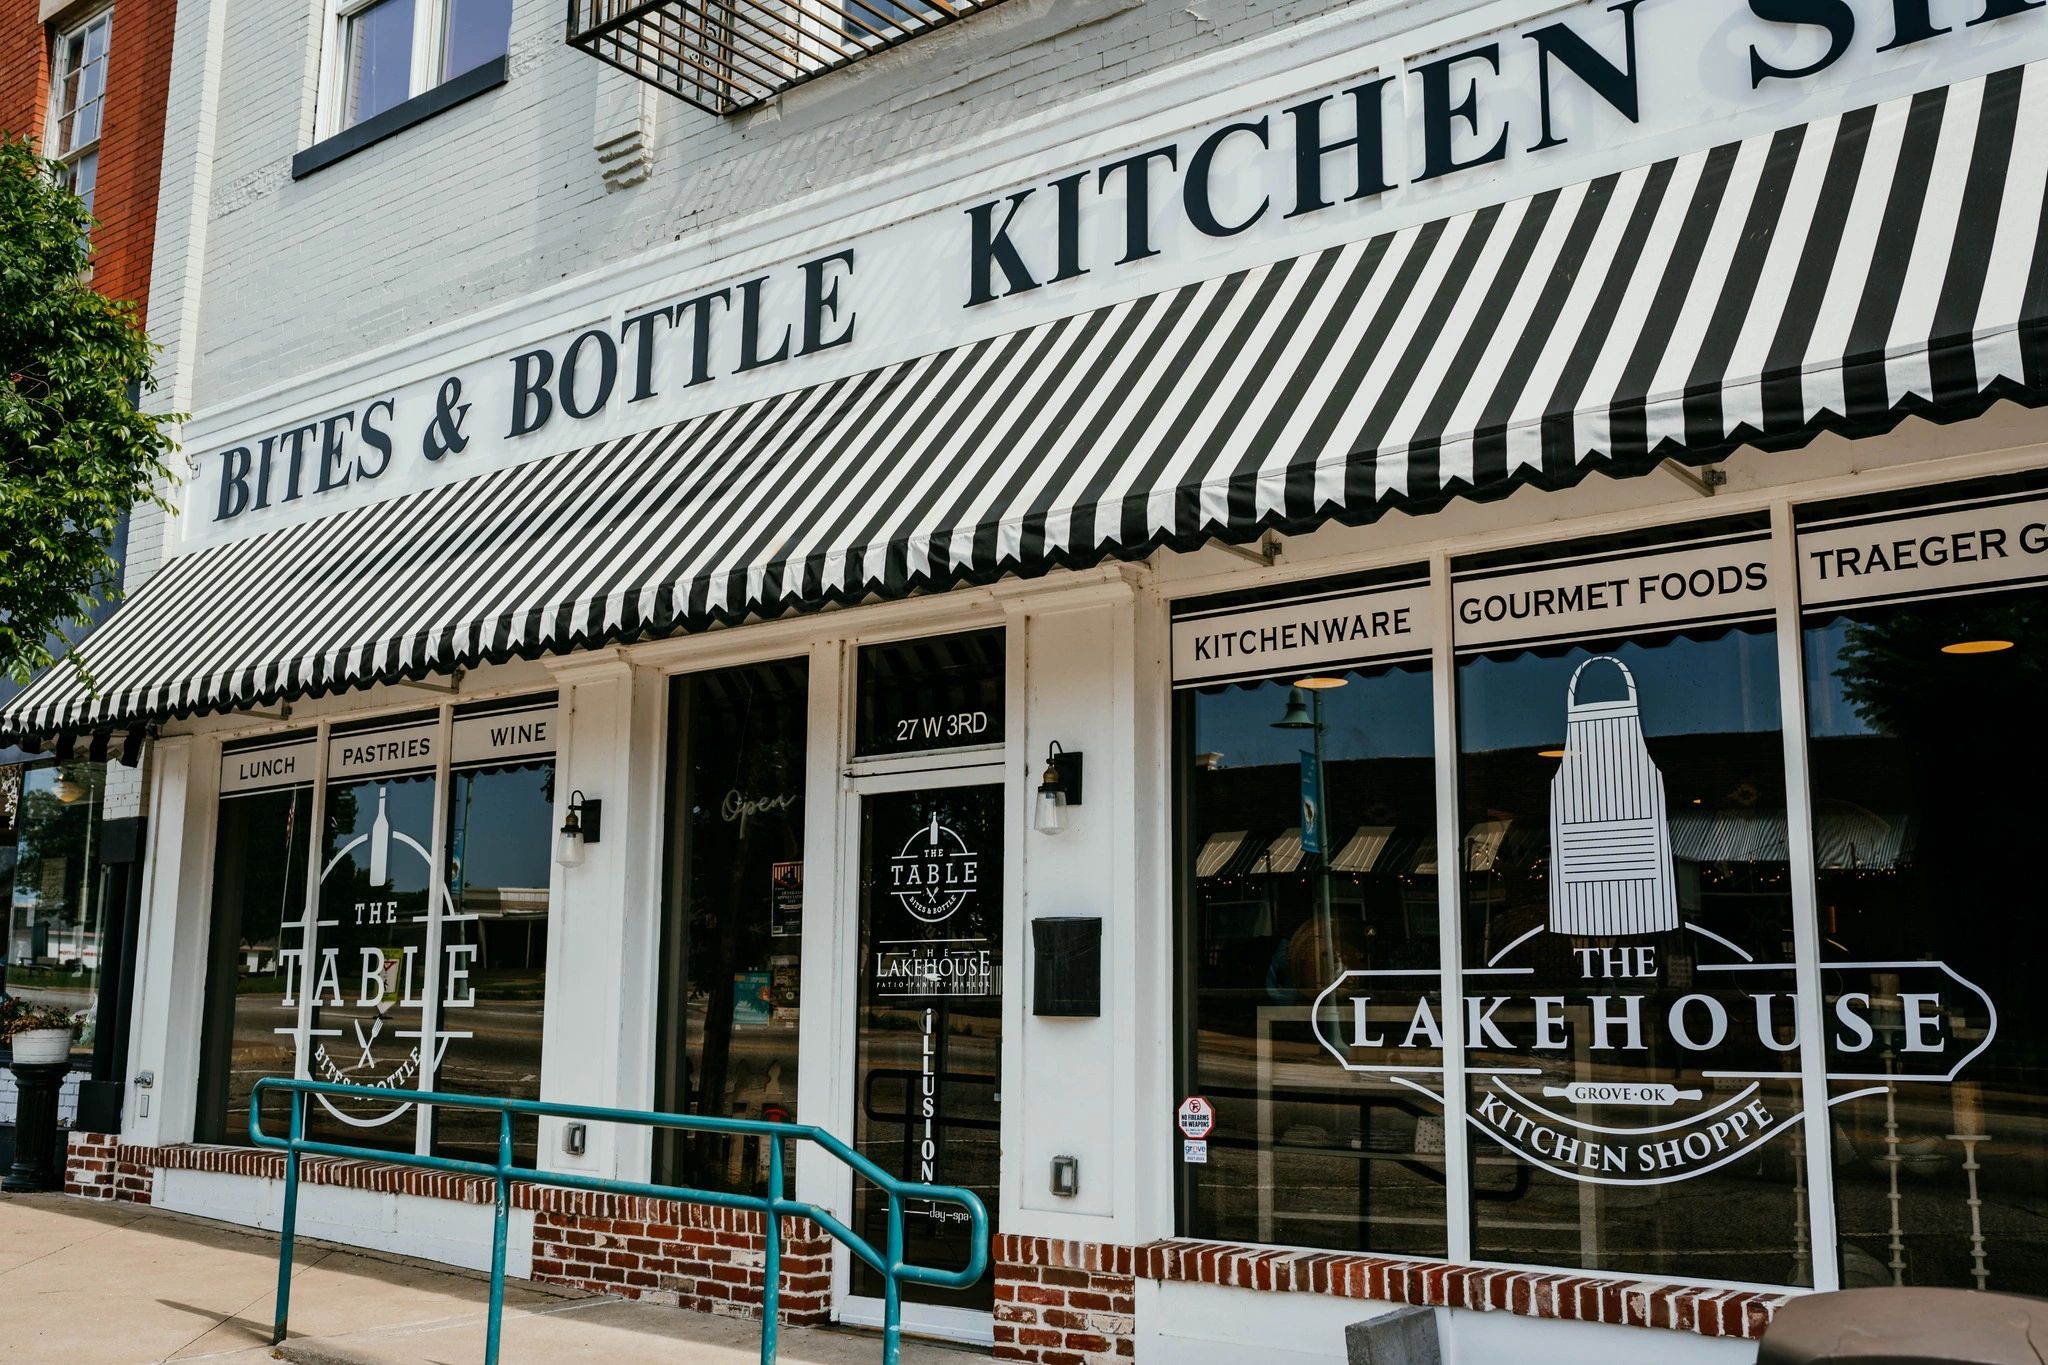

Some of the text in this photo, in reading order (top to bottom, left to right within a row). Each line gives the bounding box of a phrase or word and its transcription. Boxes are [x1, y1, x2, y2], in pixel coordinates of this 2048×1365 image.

[213, 398, 395, 522] BITES
[423, 377, 472, 461] &
[504, 249, 856, 439] BOTTLE
[963, 0, 1646, 308] KITCHEN
[1811, 529, 2008, 579] TRAEGER
[1460, 563, 1767, 624] GOURMET FOODS
[1195, 608, 1411, 660] KITCHENWARE
[491, 722, 546, 746] WINE
[897, 712, 987, 741] 27 W 3RD
[343, 738, 430, 766] PASTRIES
[240, 757, 295, 780] LUNCH
[722, 788, 796, 839] Open
[924, 849, 943, 858] THE
[891, 862, 977, 885] TABLE
[355, 902, 397, 924] THE
[909, 896, 926, 912] BITES
[932, 895, 956, 914] BOTTLE
[876, 950, 990, 978] LAKEHOUSE
[911, 949, 949, 958] THE
[1574, 947, 1658, 978] THE
[278, 944, 478, 1008] TABLE
[1349, 993, 1944, 1052] LAKEHOUSE
[921, 1008, 934, 1202] iLLUSION
[1476, 1091, 1774, 1172] KITCHEN SHOPPE
